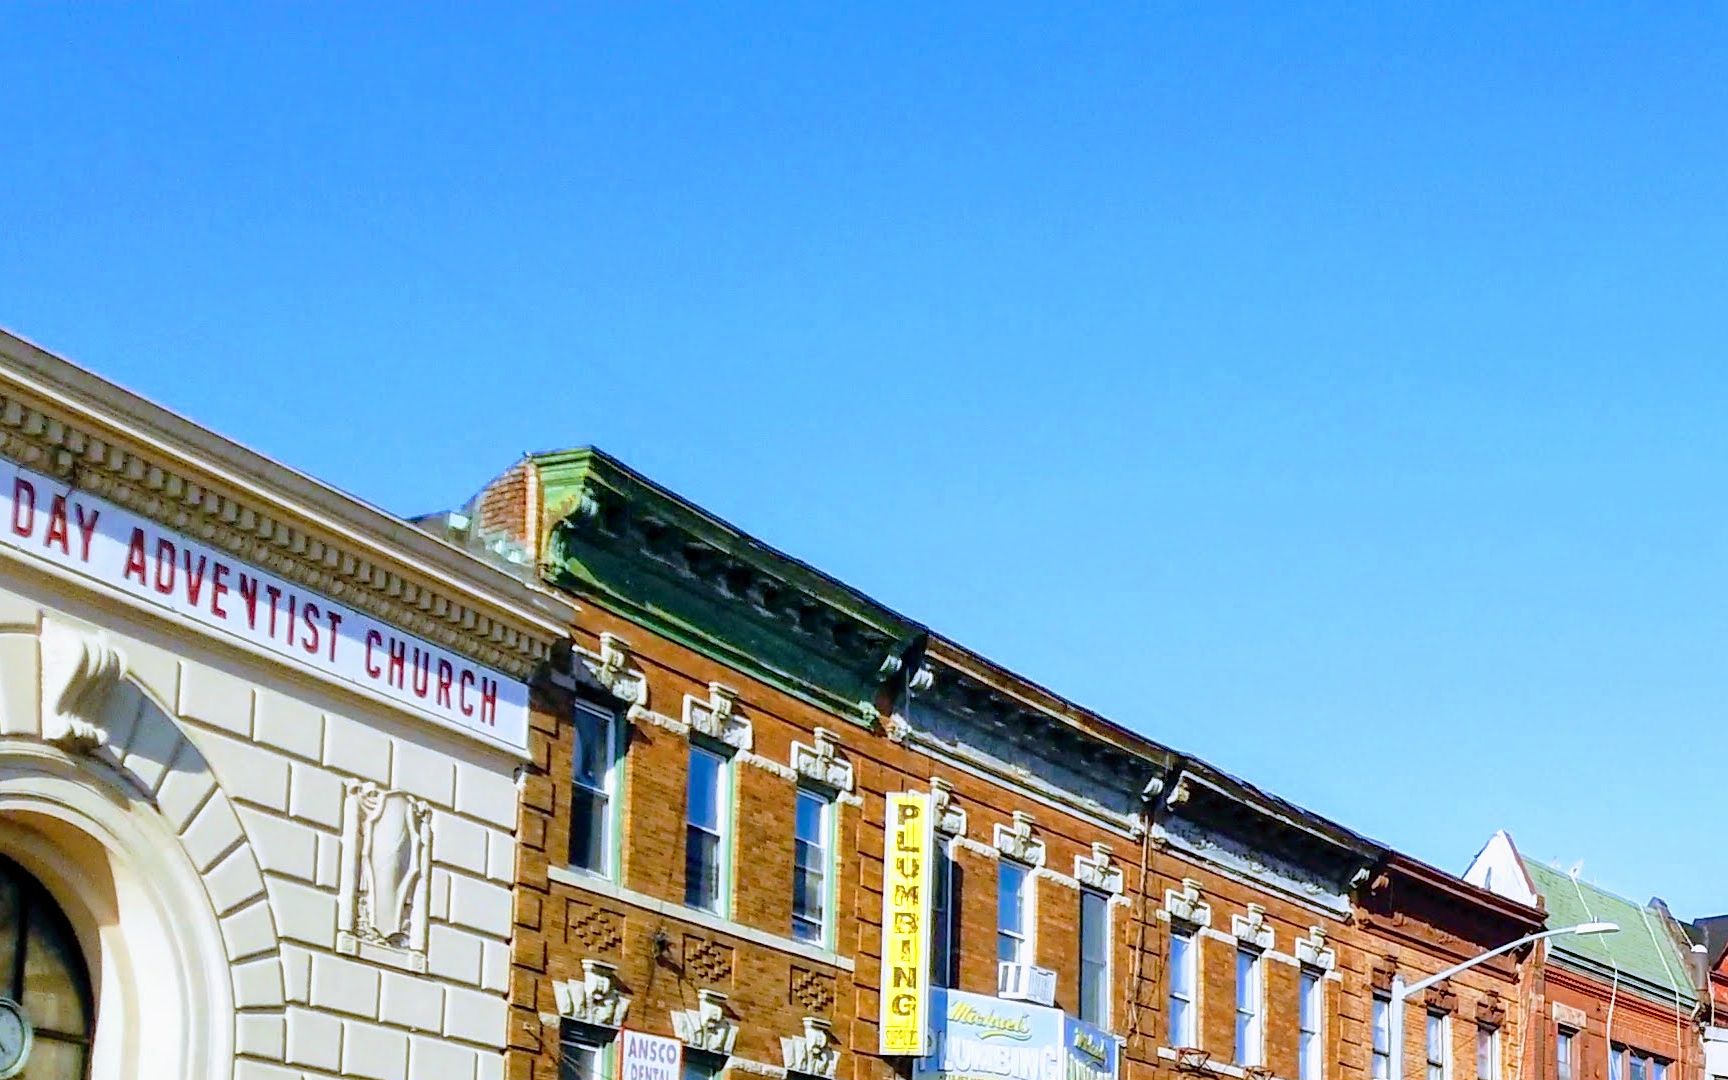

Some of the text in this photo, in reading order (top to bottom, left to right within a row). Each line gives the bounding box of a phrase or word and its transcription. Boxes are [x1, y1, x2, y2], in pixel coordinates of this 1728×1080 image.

[11, 477, 99, 563] DAY
[364, 629, 498, 727] CHURCH
[892, 803, 920, 1016] PLUMBING
[628, 1036, 677, 1065] ANSCO
